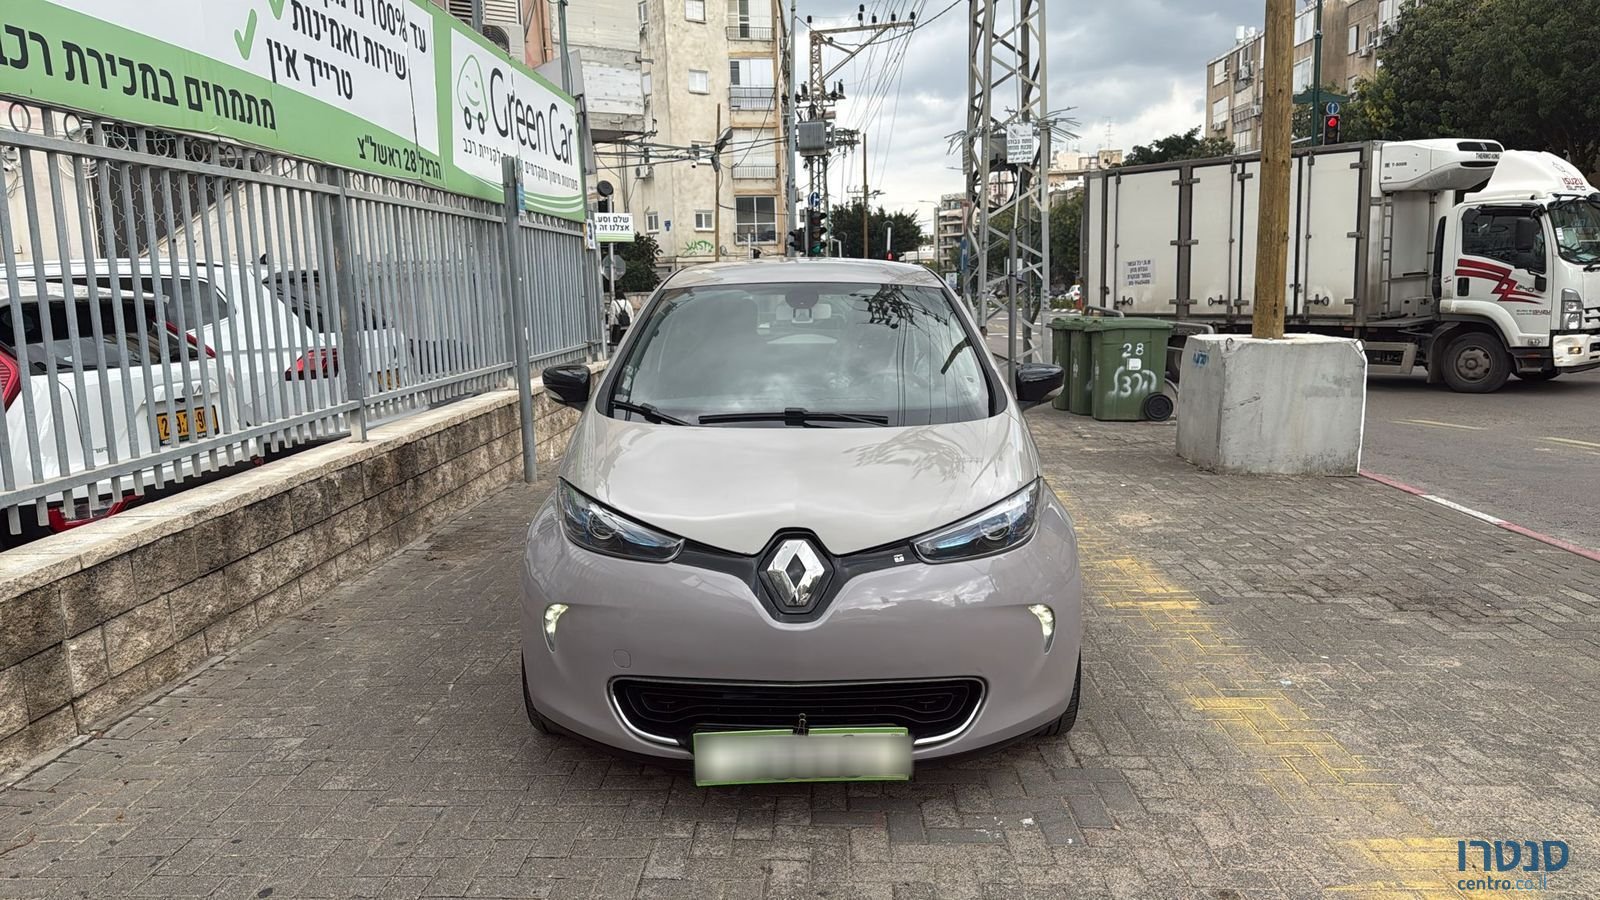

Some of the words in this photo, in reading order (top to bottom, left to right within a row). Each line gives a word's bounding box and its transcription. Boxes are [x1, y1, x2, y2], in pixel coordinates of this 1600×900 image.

[291, 0, 360, 60] ואמינות
[410, 22, 426, 53] עד
[62, 40, 179, 106] במכירת
[266, 38, 300, 84] אין
[304, 53, 353, 100] טרייד
[363, 36, 407, 80] שירות
[184, 76, 276, 130] מתמחים
[490, 67, 547, 155] Green
[548, 102, 573, 166] Car
[404, 148, 417, 172] 28
[418, 151, 442, 180] הרצל
[463, 138, 477, 155] רכב
[1562, 177, 1584, 185] ISUZU
[1122, 342, 1144, 357] 28
